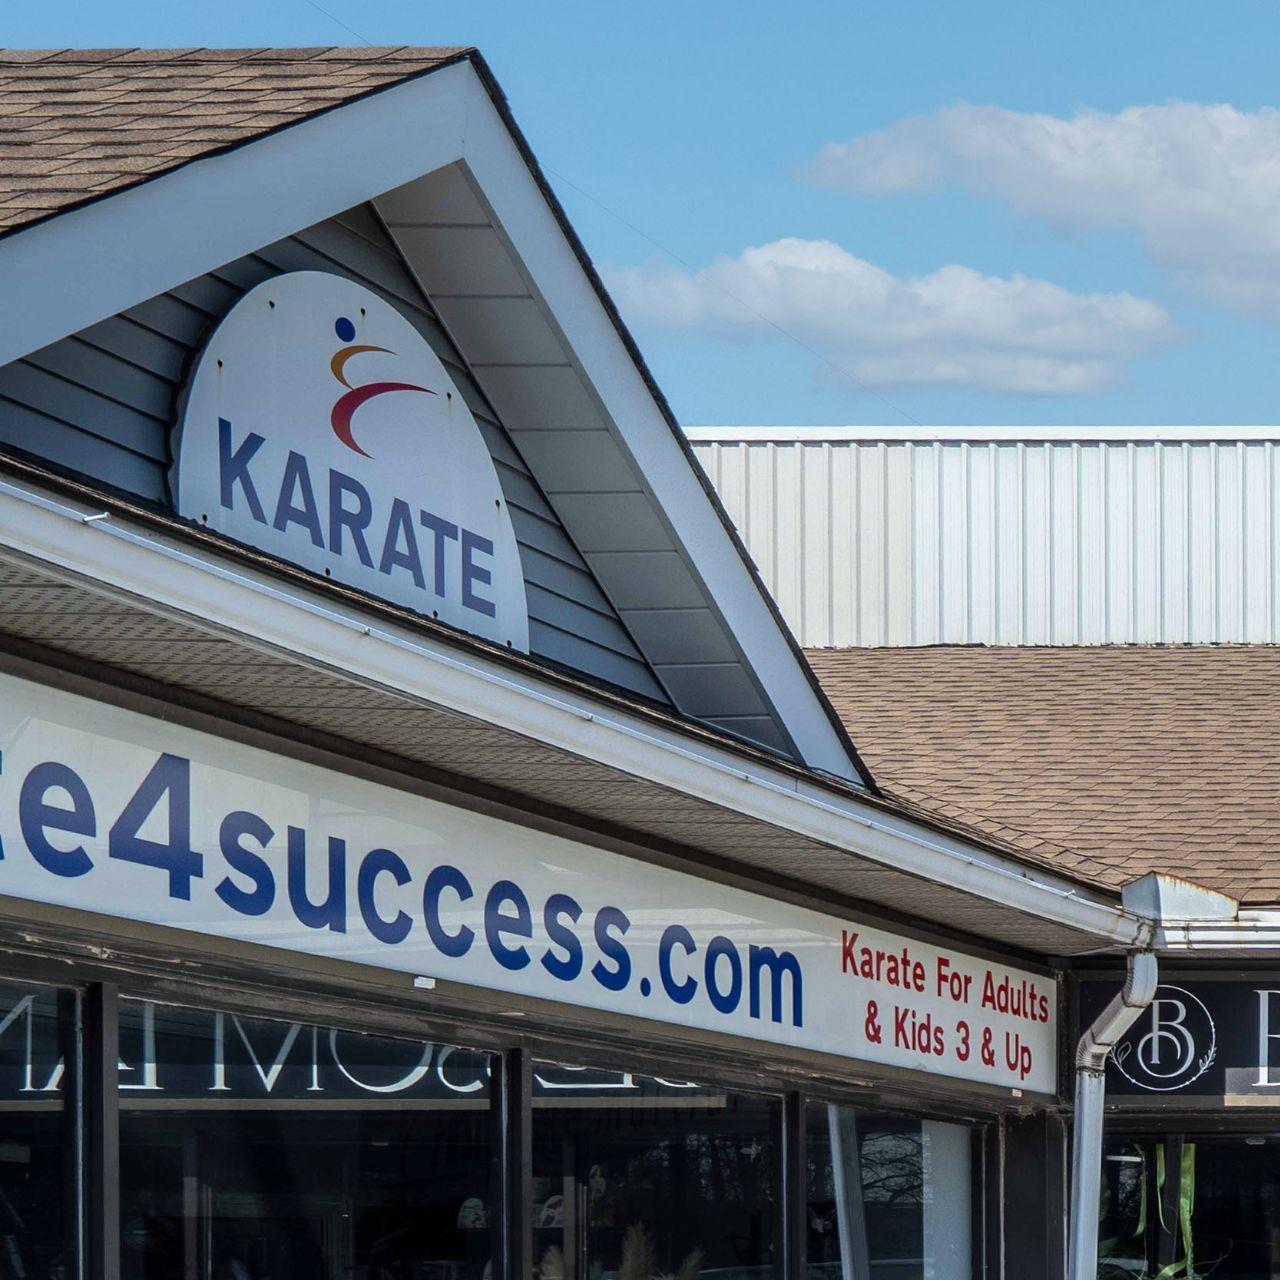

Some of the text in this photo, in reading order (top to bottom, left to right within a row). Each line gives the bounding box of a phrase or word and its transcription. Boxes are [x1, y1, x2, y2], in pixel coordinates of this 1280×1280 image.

[217, 416, 496, 618] KARATE
[0, 750, 803, 1028] e4success.com
[841, 929, 1049, 1023] Karate For Adults
[865, 1000, 1032, 1080] & Kids 3 & Up
